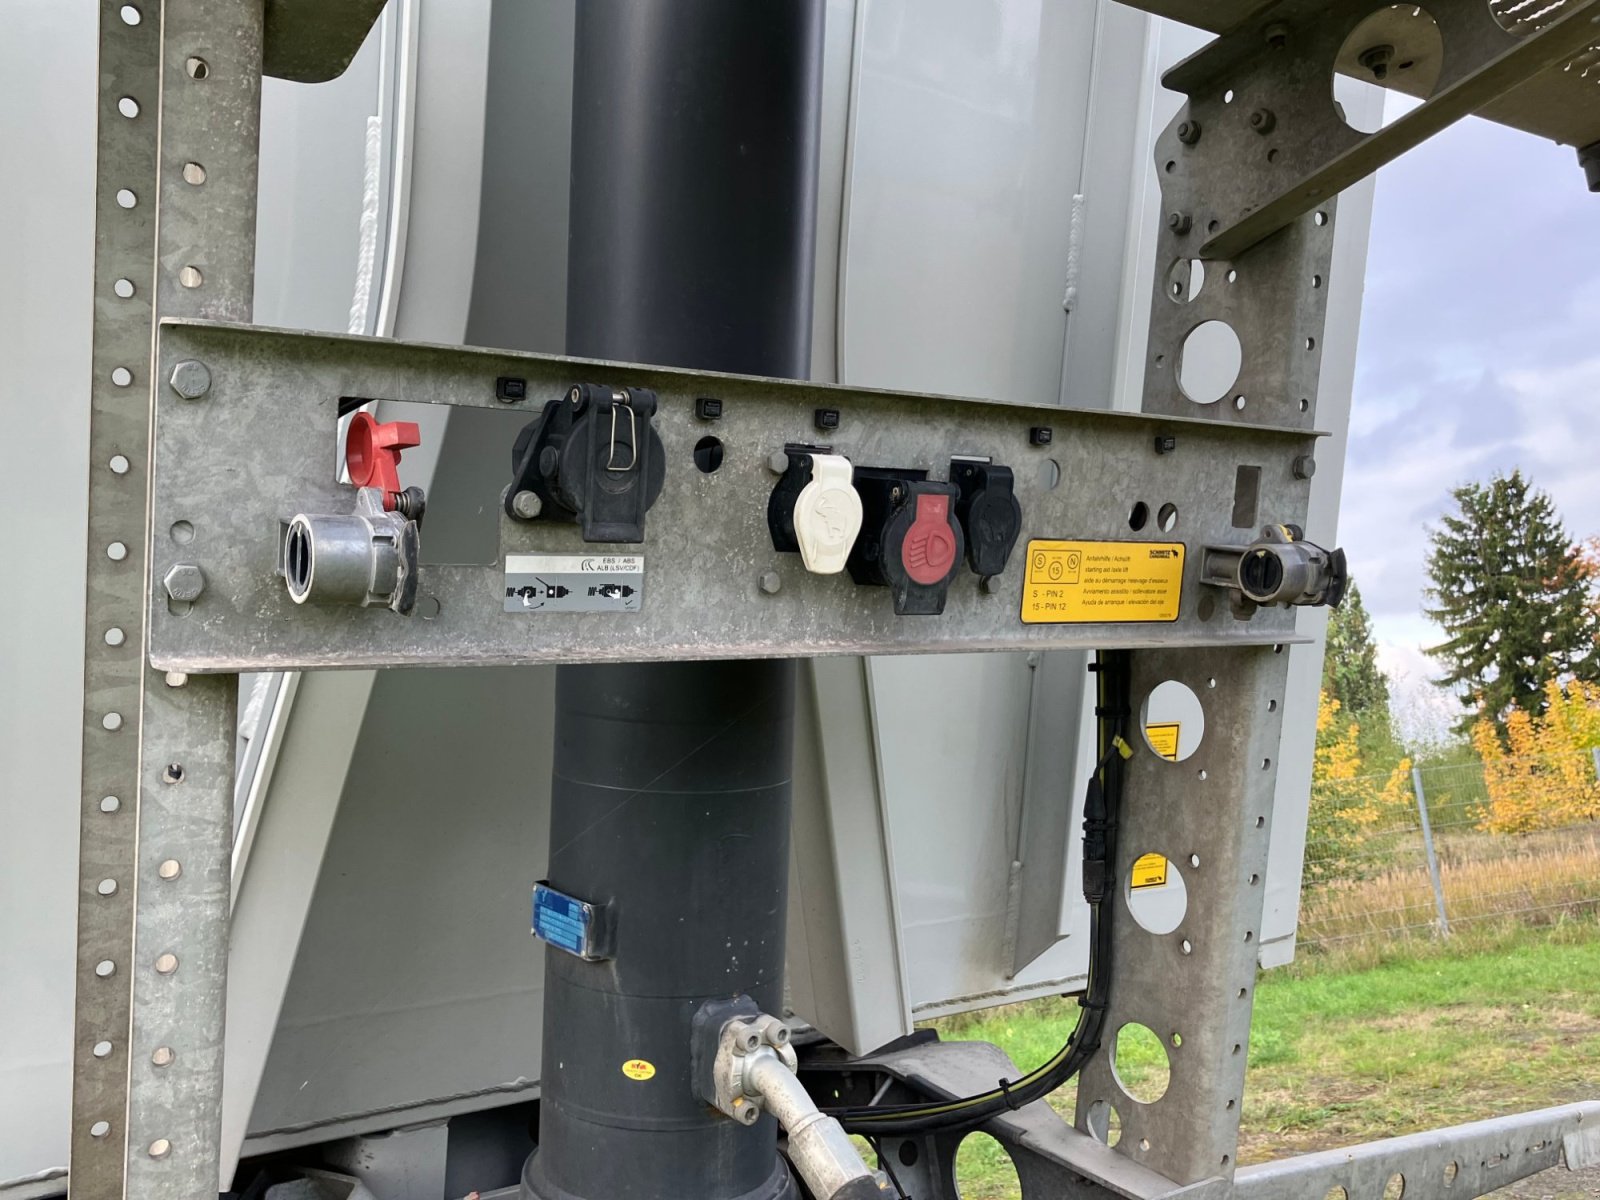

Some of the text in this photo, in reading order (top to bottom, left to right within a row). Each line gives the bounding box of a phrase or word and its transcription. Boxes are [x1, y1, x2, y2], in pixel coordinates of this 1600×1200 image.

[1037, 557, 1043, 565] S
[1070, 557, 1076, 566] N
[1052, 566, 1060, 575] 15
[1033, 590, 1038, 598] S
[1032, 603, 1040, 611] 15
